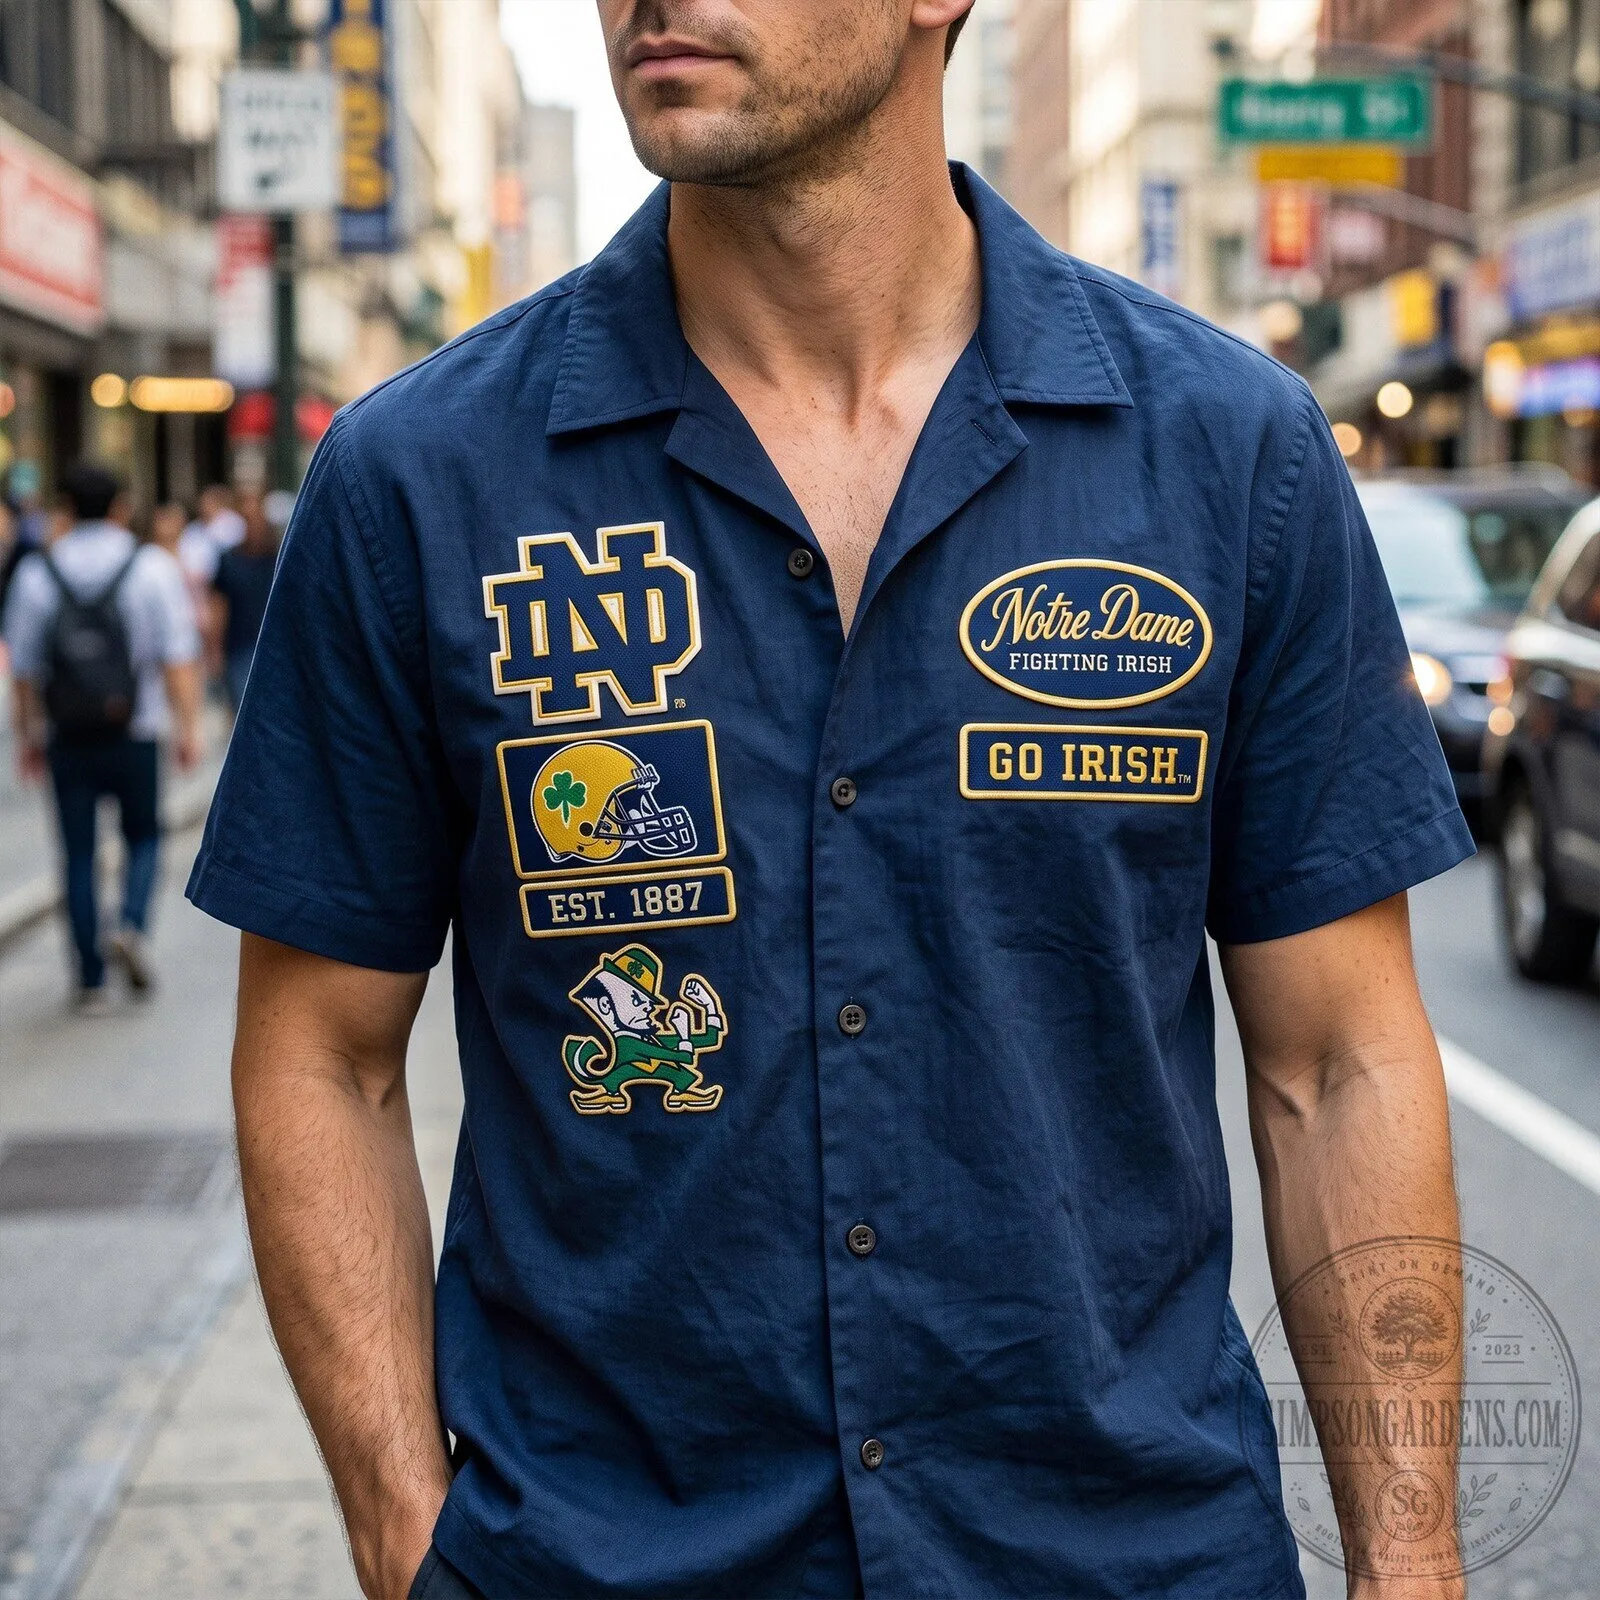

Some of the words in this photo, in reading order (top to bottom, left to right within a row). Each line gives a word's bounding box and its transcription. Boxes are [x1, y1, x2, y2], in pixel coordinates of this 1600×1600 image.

[981, 584, 1091, 651] Notre
[1091, 583, 1195, 646] Dame
[1009, 653, 1108, 671] FIGHTING
[1117, 655, 1172, 673] IRISH
[989, 742, 1043, 781] GO
[1062, 744, 1178, 784] IRISH
[548, 891, 615, 923] EST.
[630, 881, 703, 917] 1887
